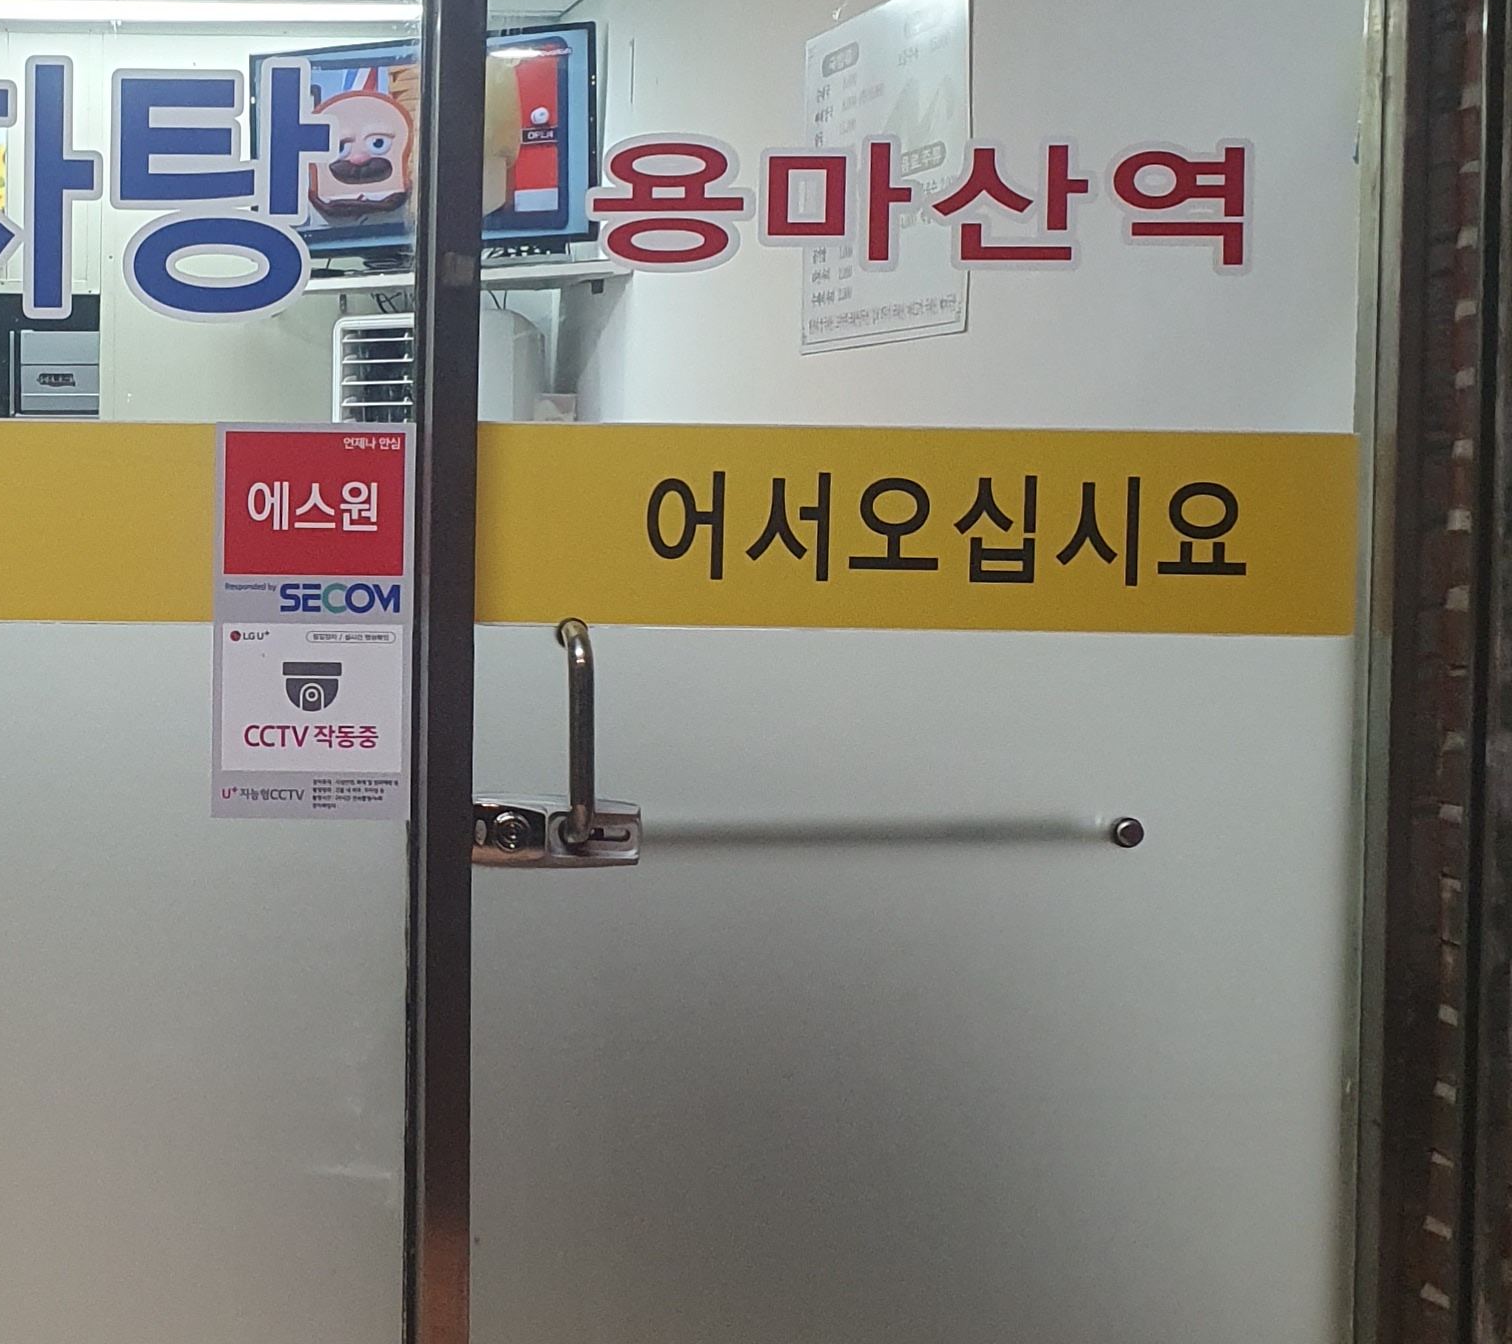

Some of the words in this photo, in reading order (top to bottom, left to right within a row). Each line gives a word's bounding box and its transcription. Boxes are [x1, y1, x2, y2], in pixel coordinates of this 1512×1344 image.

[591, 141, 1246, 266] 용마산역
[343, 436, 377, 450] 언제나
[378, 436, 401, 451] 안심
[247, 480, 379, 532] 에스원
[645, 470, 1248, 587] 어서오십시요
[279, 582, 402, 615] SECOM
[244, 724, 310, 749] CCTV
[313, 724, 380, 749] 작동중
